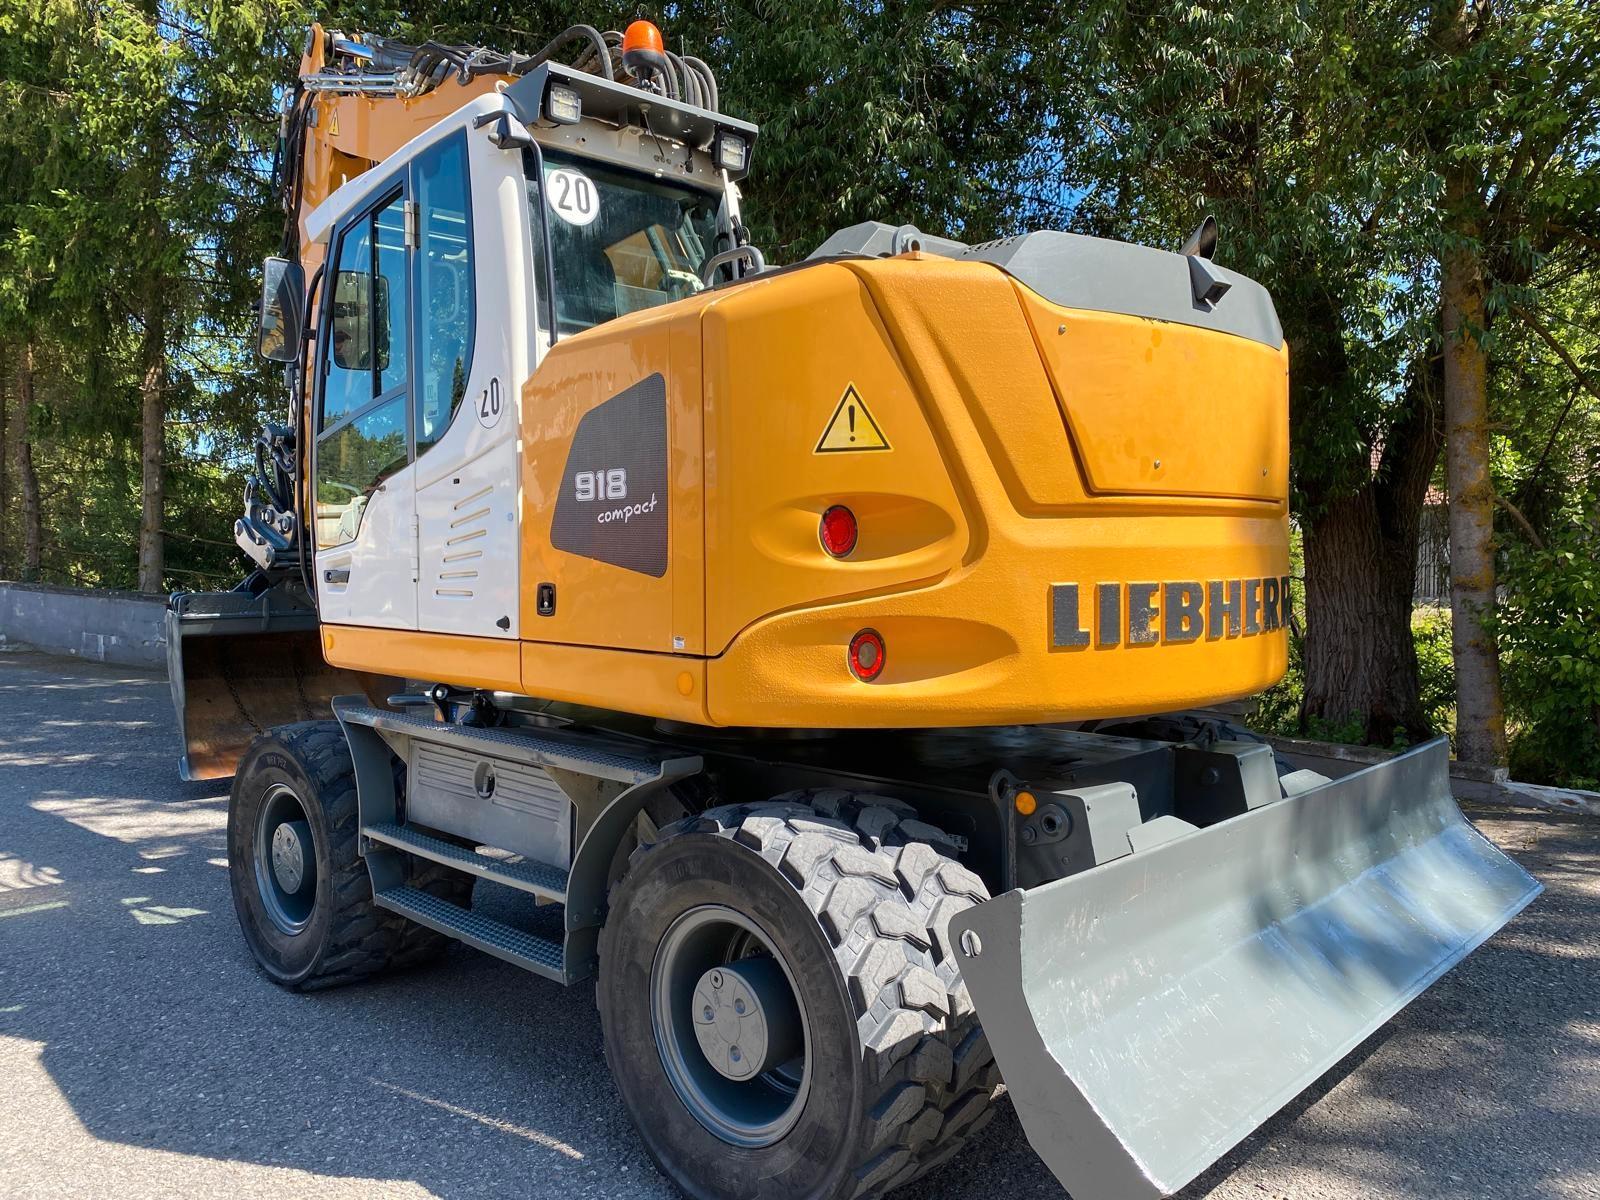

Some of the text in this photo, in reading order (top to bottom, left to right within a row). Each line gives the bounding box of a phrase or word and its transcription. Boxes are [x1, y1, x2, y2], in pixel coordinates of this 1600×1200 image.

[556, 173, 590, 214] 20
[575, 468, 627, 502] 918
[597, 492, 658, 524] compact
[1048, 576, 1292, 652] LIEBHERR
